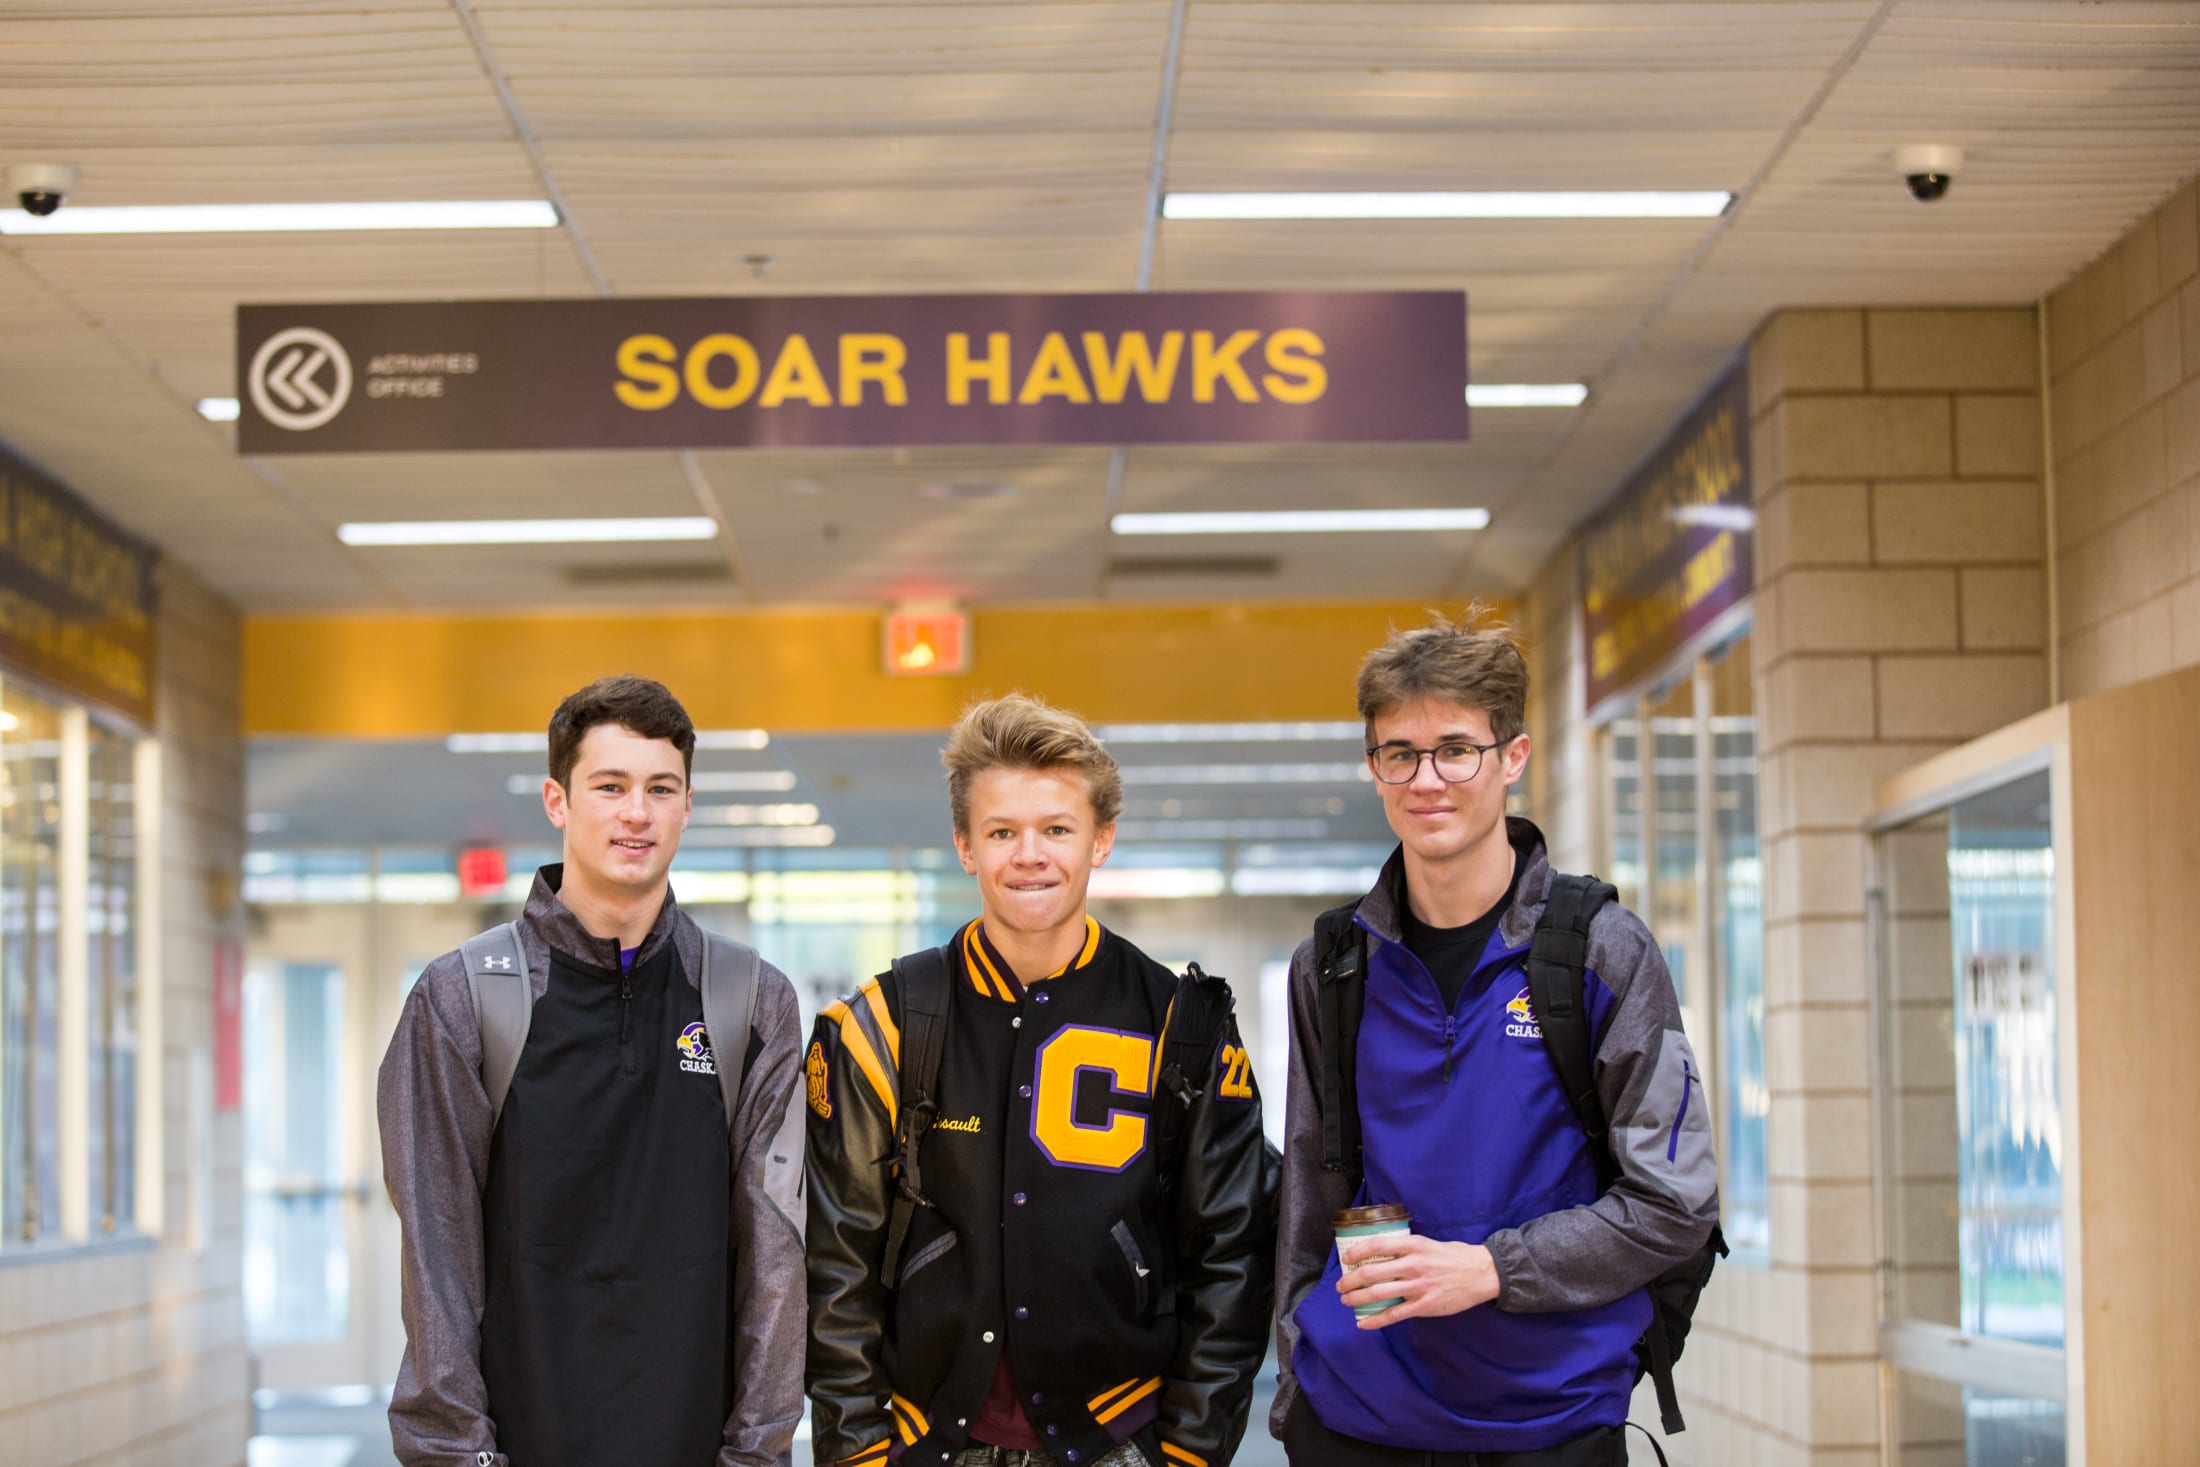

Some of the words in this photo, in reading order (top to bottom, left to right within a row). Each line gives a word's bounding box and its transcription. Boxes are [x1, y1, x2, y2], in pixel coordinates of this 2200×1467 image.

[367, 353, 479, 374] ACTIVITIES
[613, 333, 908, 411] SOAR
[945, 327, 1329, 405] HAWKS
[367, 376, 445, 399] OFFICE
[680, 1059, 716, 1075] CHASK
[1218, 1042, 1253, 1100] 22
[1029, 1023, 1155, 1174] C
